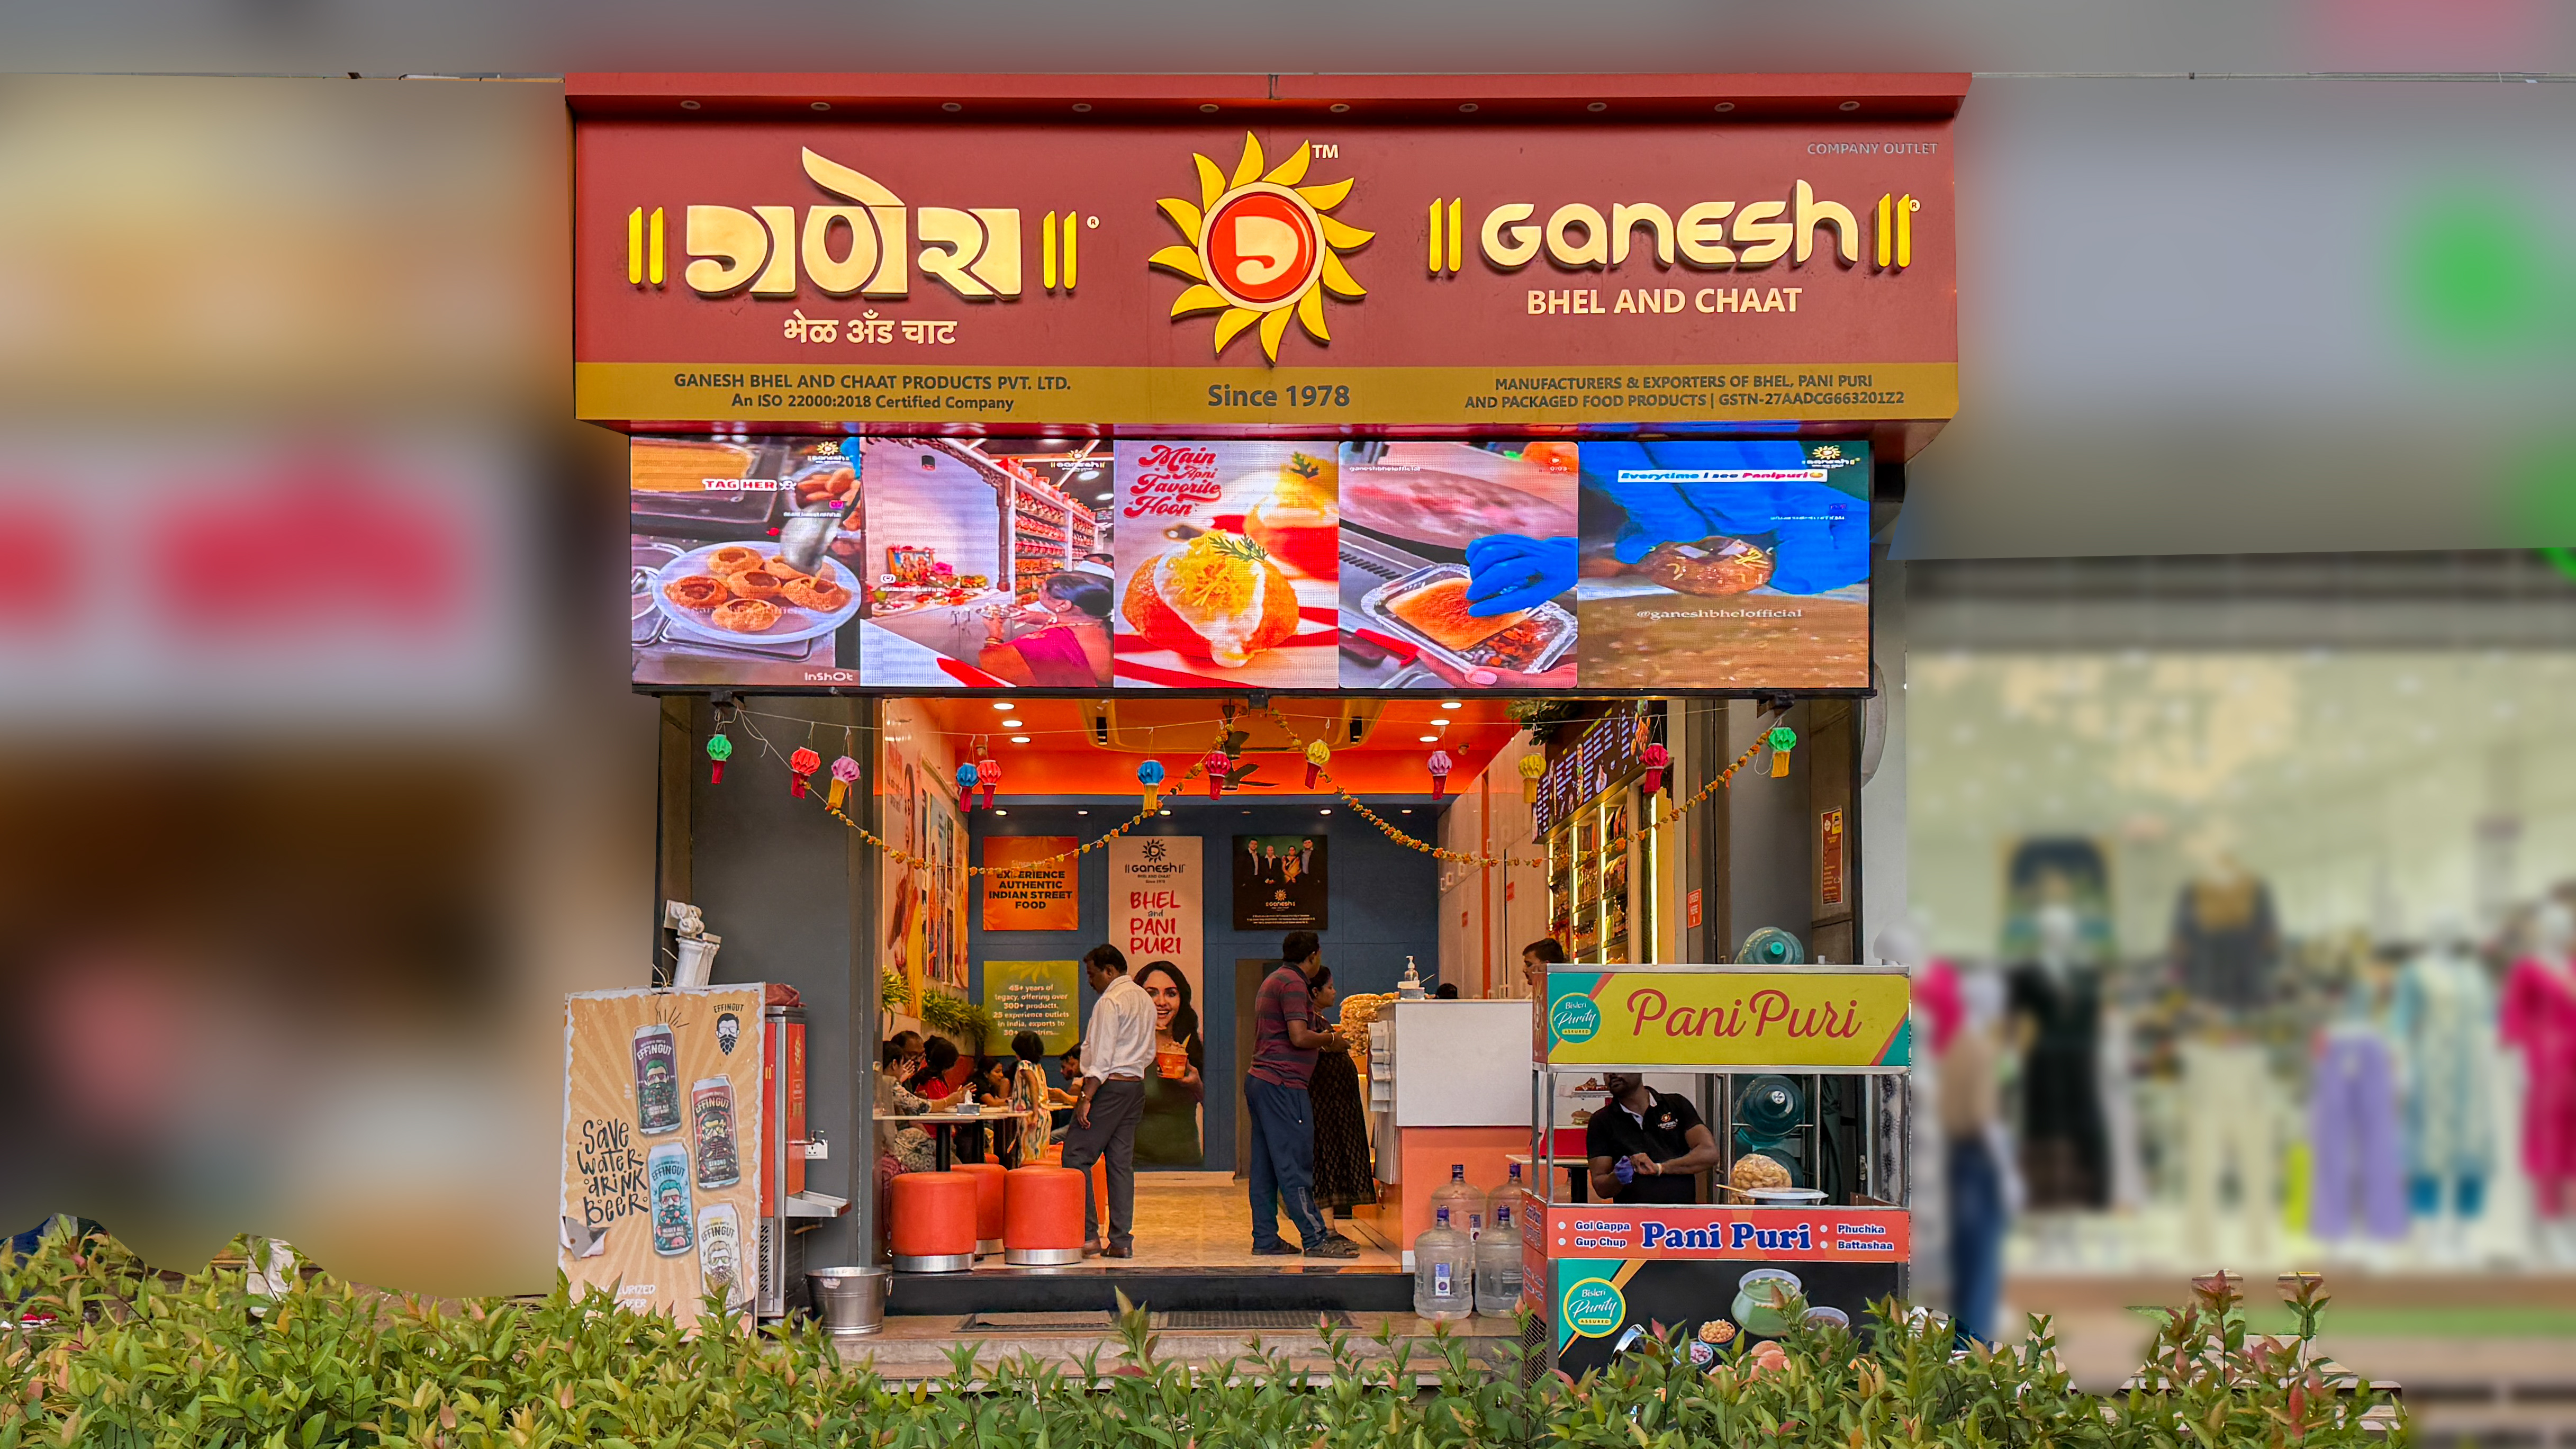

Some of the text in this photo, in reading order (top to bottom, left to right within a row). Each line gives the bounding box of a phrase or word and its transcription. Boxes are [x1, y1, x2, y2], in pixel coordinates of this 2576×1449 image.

[1807, 142, 1938, 155] COMPANY OUTLET
[1527, 287, 1802, 315] BHEL AND CHAAT
[902, 318, 957, 345] चाट
[674, 374, 1071, 391] GANESH BHEL AND CHAAT PRODUCTS PVT. LTD.
[1496, 377, 1622, 391] MANUFACTURERS
[1627, 377, 1639, 390] &
[1642, 376, 1725, 390] EXPORTERS
[1729, 376, 1748, 389] OF
[1798, 375, 1832, 388] PANI
[1838, 375, 1872, 388] PURI
[731, 394, 1014, 412] An ISO 22000:2018 Certified Company
[1208, 384, 1350, 407] Since 1978
[1465, 395, 1498, 408] AND
[1502, 394, 1578, 408] PACKAGED
[1583, 394, 1621, 407] FOOD
[1628, 393, 1707, 406] PRODUCTS
[1138, 445, 1216, 471] Main
[1173, 466, 1218, 480] Apni
[707, 480, 776, 490] TAG HER
[1130, 474, 1221, 502] Favorite
[1123, 496, 1193, 518] Hoon
[1637, 609, 1802, 620] @ganeshbhelofficial
[1130, 890, 1181, 910] BHEL
[1130, 917, 1176, 936] PANI
[1130, 937, 1181, 954] PURI
[1022, 993, 1050, 1001] offering
[713, 1003, 744, 1013] EFFINGUT
[1627, 988, 1862, 1039] Pani Puri
[1554, 1009, 1596, 1028] Purity
[637, 1043, 672, 1060] EFFINGUT
[695, 1097, 729, 1113] EFFINGUT
[652, 1165, 685, 1181] EFFINGUT
[701, 1226, 735, 1242] EFFINGUT
[1575, 1221, 1886, 1250] Gol Gappa Pani Puri Phuchka
[1575, 1237, 1894, 1251] Gup Chup Battashaa
[1582, 1288, 1606, 1297] Bisleri
[1569, 1297, 1617, 1318] Purity
